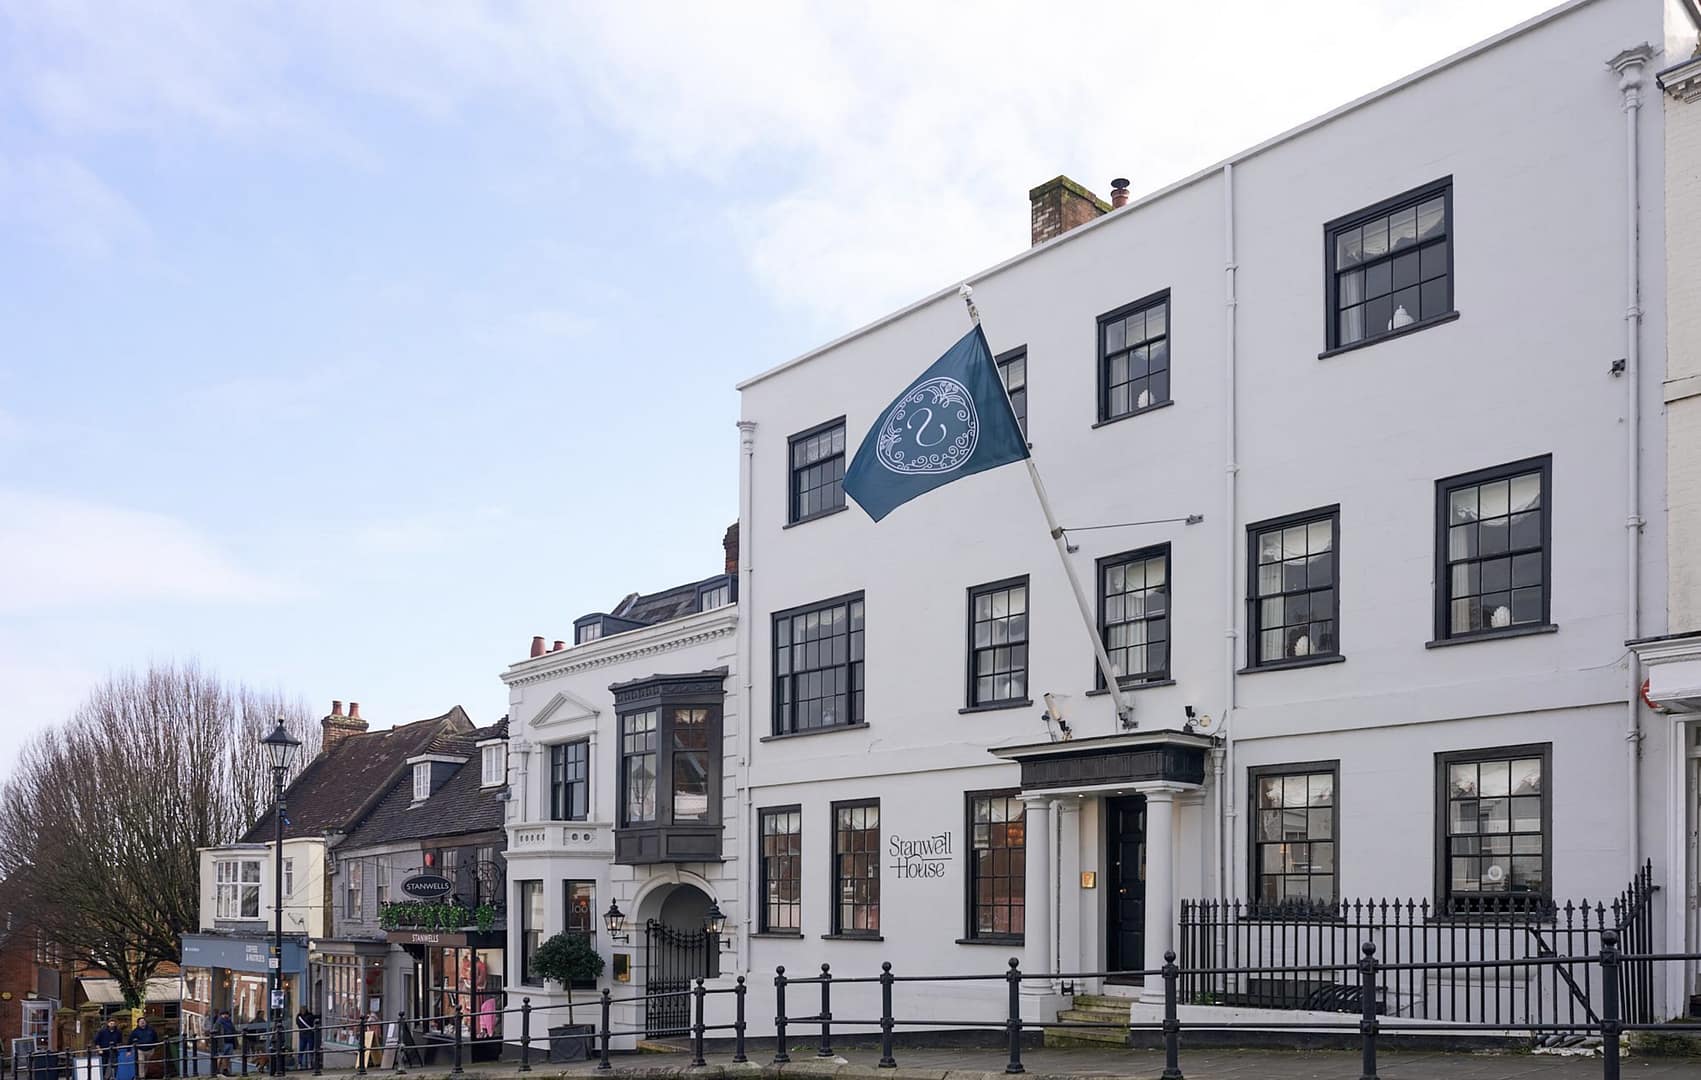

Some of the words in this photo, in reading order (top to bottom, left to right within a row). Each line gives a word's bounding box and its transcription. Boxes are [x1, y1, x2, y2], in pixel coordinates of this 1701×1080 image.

[889, 831, 952, 857] Stanwell
[889, 856, 945, 878] House
[406, 882, 450, 890] STANWELLS
